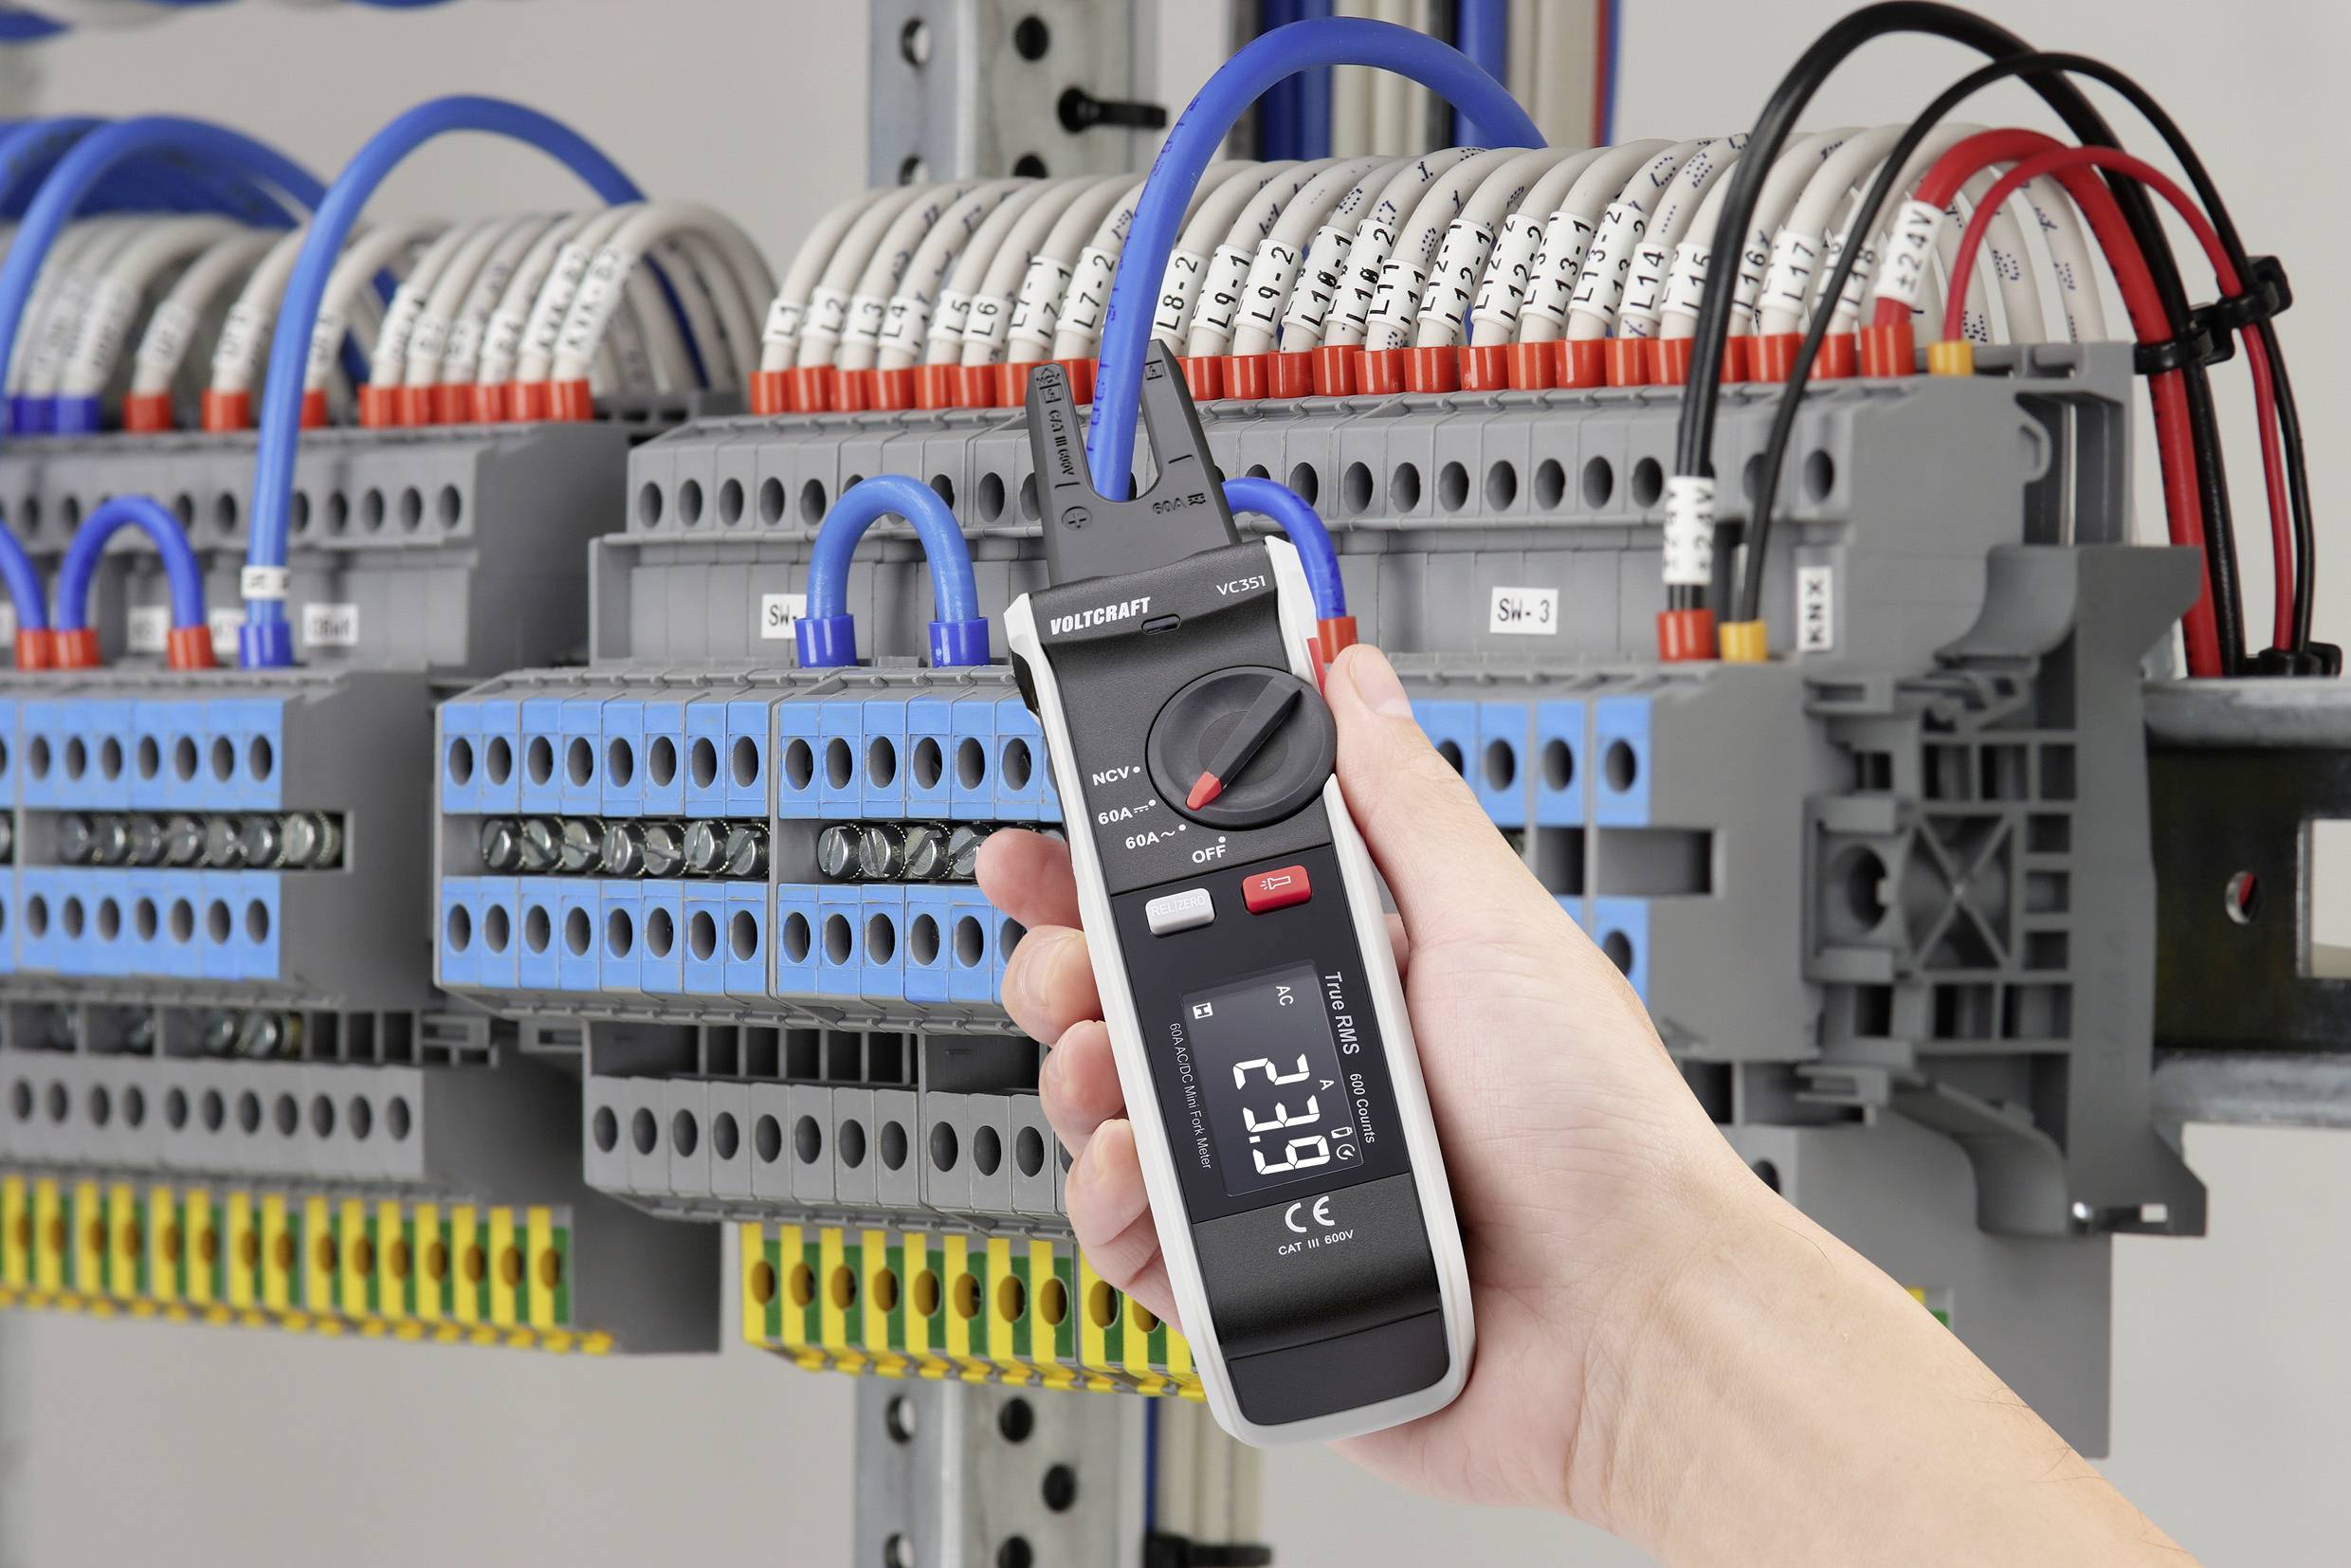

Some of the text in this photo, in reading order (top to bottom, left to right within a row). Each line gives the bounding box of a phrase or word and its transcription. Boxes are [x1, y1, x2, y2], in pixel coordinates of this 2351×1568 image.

[1546, 220, 1592, 316] L13-1
[1573, 210, 1622, 302] L13-2
[1781, 241, 1815, 302] L17
[1072, 254, 1115, 329] L7-2
[1156, 256, 1198, 330] L8-2
[1207, 253, 1250, 328] L9-1
[1250, 246, 1295, 322] L9-2
[1369, 264, 1400, 316] L11
[1629, 248, 1666, 310] L14
[773, 305, 801, 337] L1
[820, 298, 846, 334] L2
[857, 302, 884, 336] L3
[882, 304, 909, 337] L4
[944, 300, 972, 334] L5
[971, 302, 998, 337] L6
[1215, 574, 1267, 596] VC351
[1049, 596, 1151, 636] VOLTCRAFT
[1091, 766, 1130, 786] NCV
[1192, 844, 1227, 864] OFF
[1275, 986, 1295, 1006] AC
[1324, 971, 1360, 1055] True RMS
[1169, 1023, 1212, 1170] 60A AC/DC Mini Fork Meter
[1319, 1079, 1335, 1091] A
[1232, 1053, 1331, 1176] 23.9
[1349, 1072, 1376, 1144] 600 Counts
[1285, 1194, 1336, 1233] CE
[1278, 1230, 1354, 1256] CAT III 600V
